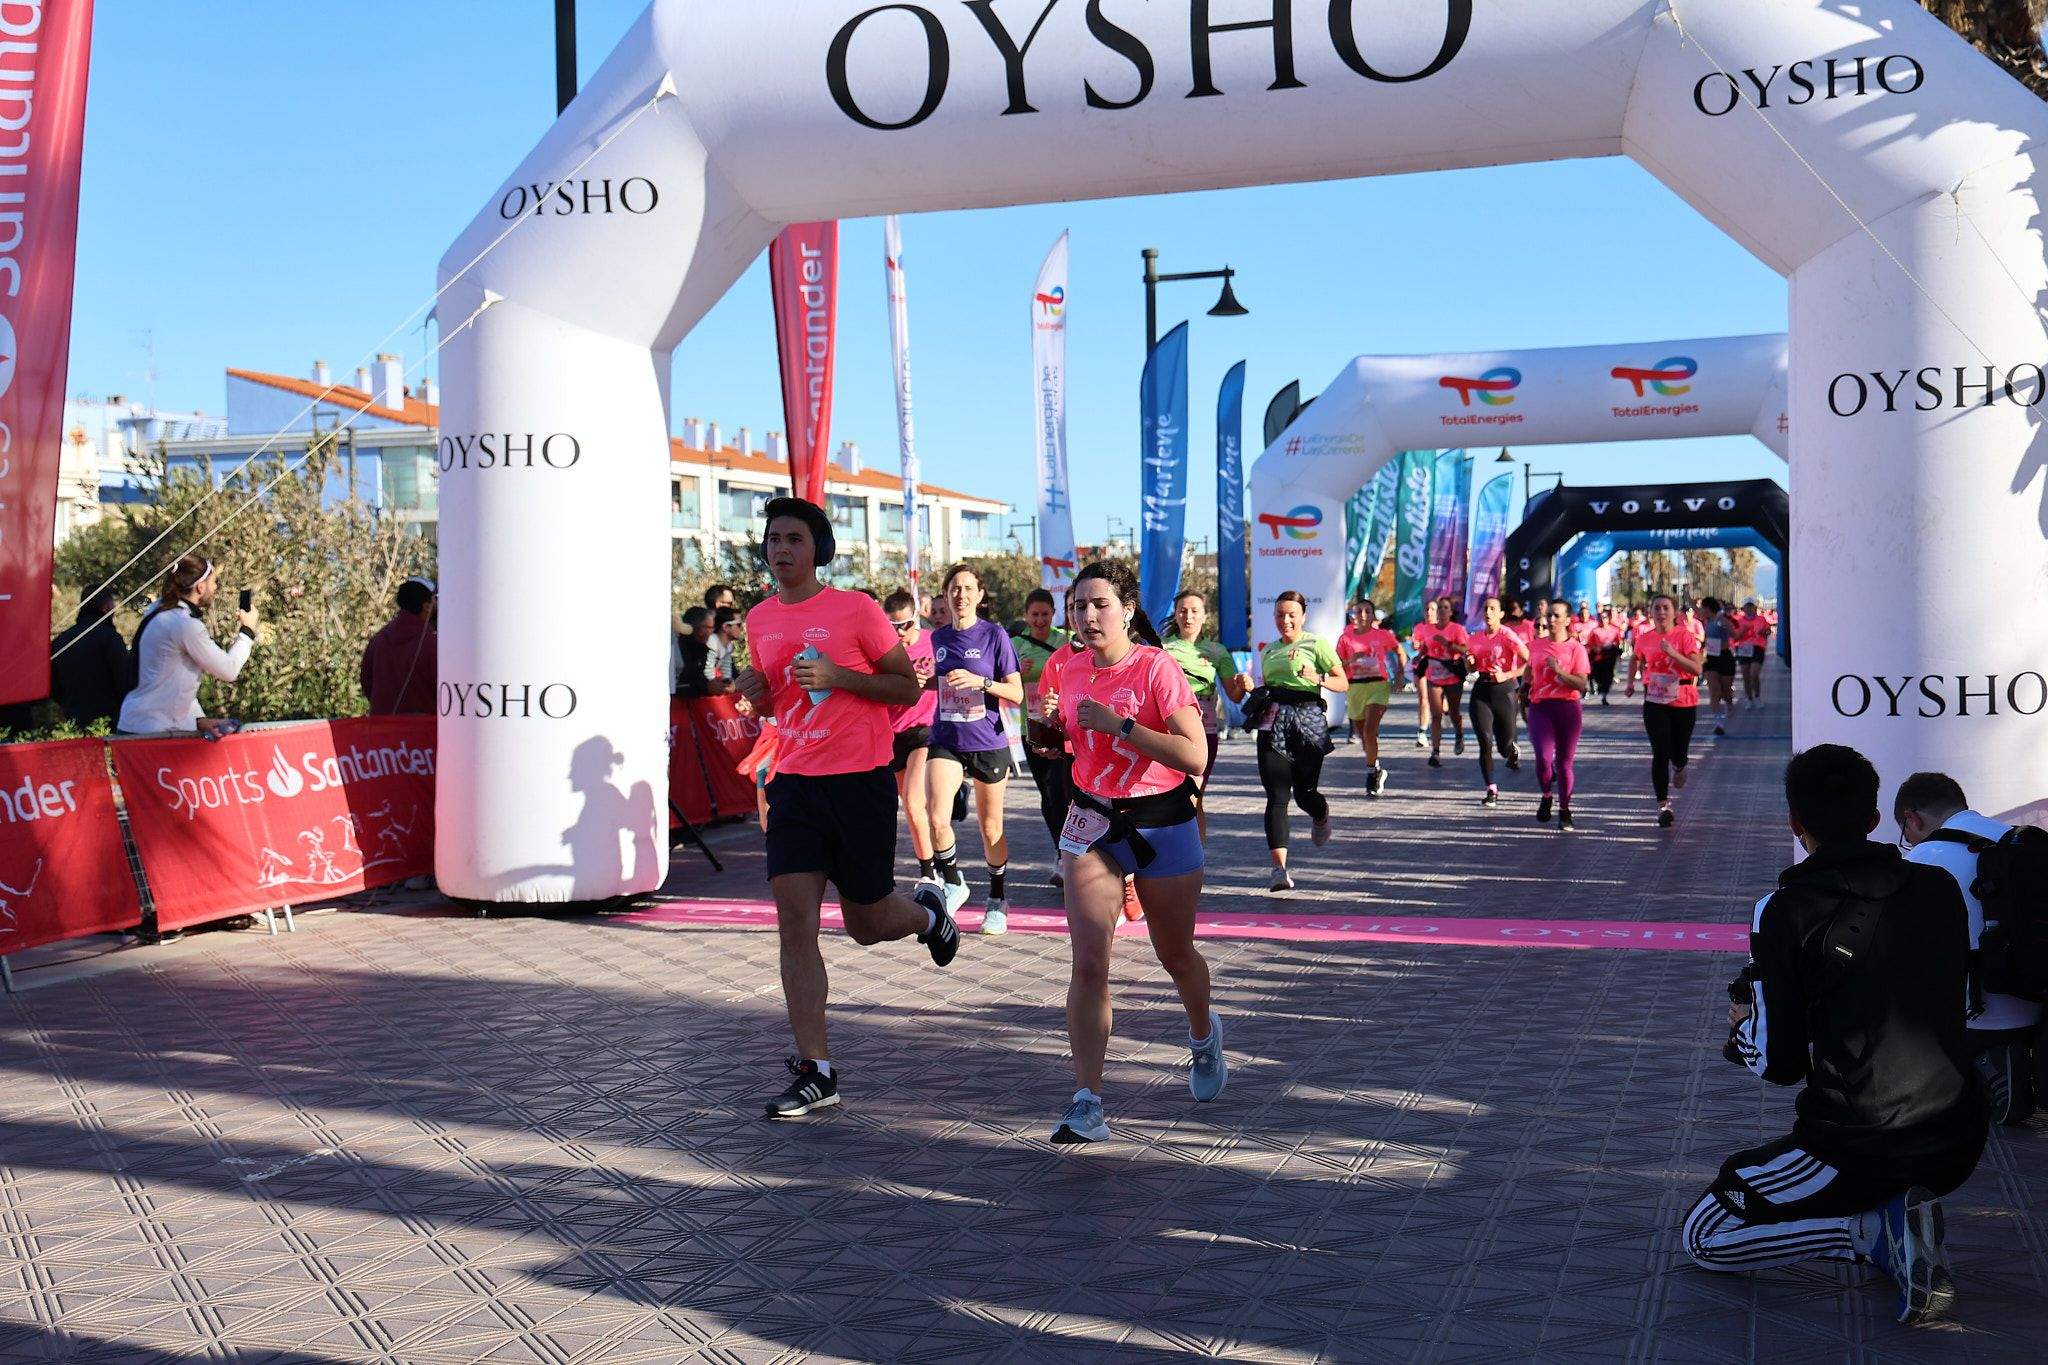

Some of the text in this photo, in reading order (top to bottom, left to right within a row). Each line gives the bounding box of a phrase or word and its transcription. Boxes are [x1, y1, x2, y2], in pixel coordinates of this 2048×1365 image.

[826, 0, 1472, 131] OYSHO
[1694, 55, 1924, 116] OYSHO
[500, 177, 659, 220] OYSHO
[1612, 404, 1699, 418] TotalEnergies
[1828, 363, 2046, 417] OYSHO
[1440, 413, 1523, 426] TotalEnergies
[440, 433, 580, 471] OYSHO
[1144, 413, 1186, 531] Marlene
[1219, 435, 1244, 542] Marlene
[1588, 497, 1736, 515] VOLVO
[1399, 465, 1431, 580] Batiste
[1259, 547, 1323, 558] TotalEnergies
[440, 682, 578, 719] OYSHO
[1831, 671, 2048, 718] OYSHO
[157, 740, 435, 820] Sports Santander
[1208, 920, 1440, 933] OYSHO
[1500, 928, 1749, 940] OYSHO
